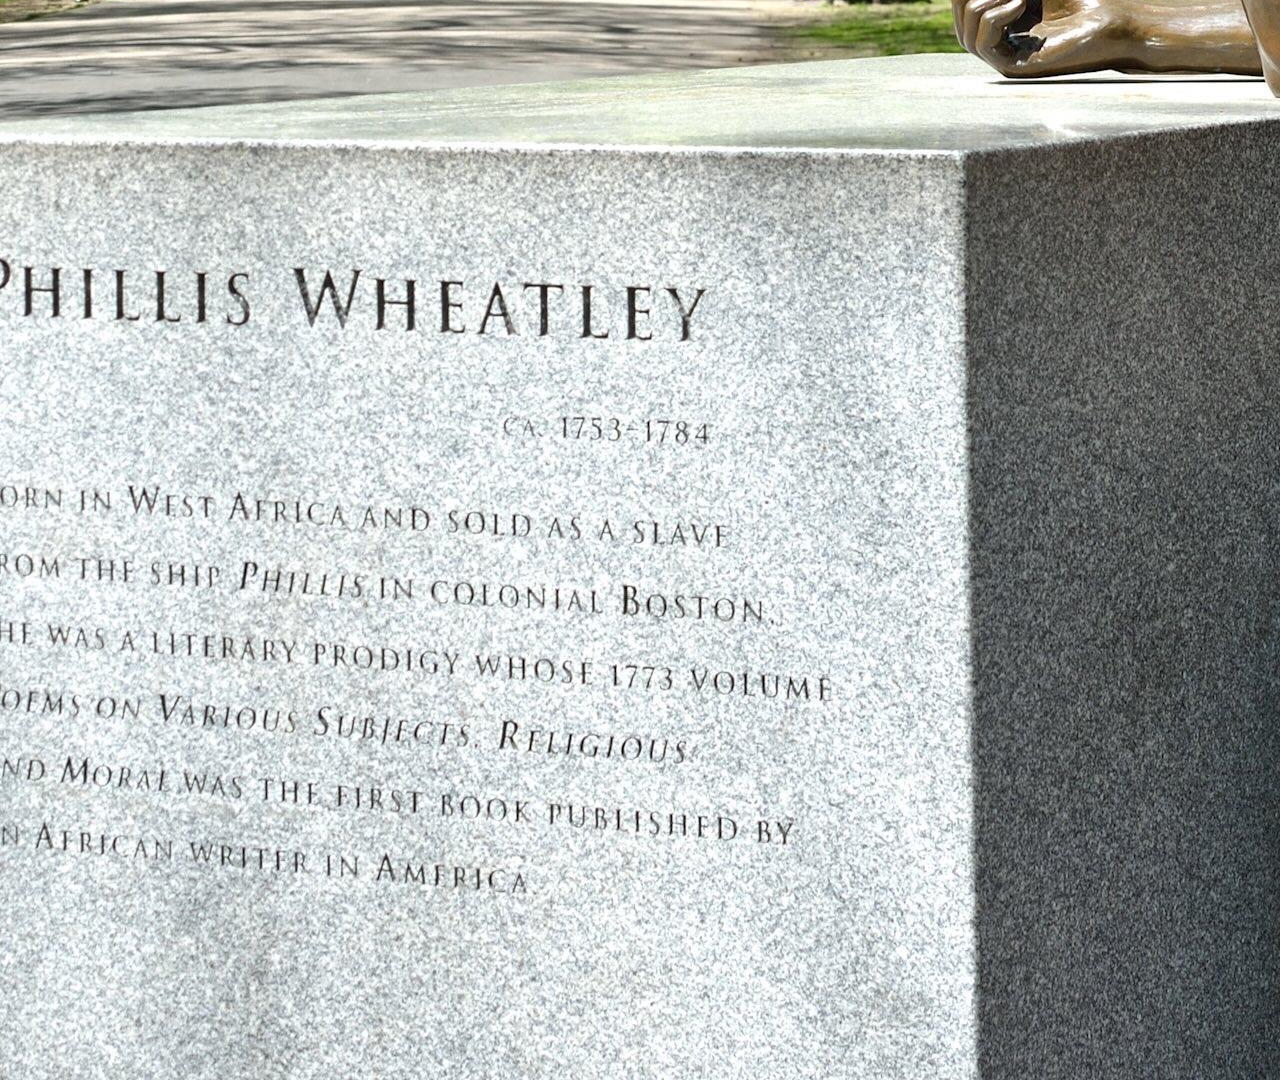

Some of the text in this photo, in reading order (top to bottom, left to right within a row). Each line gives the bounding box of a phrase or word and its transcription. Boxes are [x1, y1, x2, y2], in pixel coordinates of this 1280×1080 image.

[292, 267, 708, 342] WHEATLEY
[561, 416, 709, 445] 1753-1784
[80, 489, 112, 512] IN
[127, 485, 215, 519] WEST
[228, 492, 349, 528] AFRICA
[363, 505, 430, 532] AND
[447, 510, 532, 537] SOLD
[547, 517, 582, 540] AS
[598, 519, 615, 541] A
[633, 520, 728, 547] SLAVE
[76, 557, 135, 583] THE
[150, 562, 220, 588] SHIP
[239, 561, 363, 598] PHILLIS
[380, 577, 413, 600] IN
[430, 580, 603, 614] COLONIAL
[46, 624, 105, 650] WAS
[120, 630, 136, 652] A
[153, 631, 298, 664] LITERARY
[314, 643, 459, 675] PRODIGY
[475, 654, 593, 685] WHOSE
[611, 664, 673, 691] 1773
[690, 668, 832, 701] VOLUME
[96, 696, 142, 720] ON
[159, 694, 298, 734] VARIOUS
[499, 720, 687, 764] RELIGIOUS
[61, 756, 168, 792] MORAL
[183, 772, 243, 799] WAS
[260, 778, 319, 805] THE
[337, 785, 424, 813] FIRST
[441, 794, 529, 822] BOOK
[549, 803, 738, 841] PUBLISHED
[757, 821, 794, 845] BY
[35, 822, 173, 861] AFRICAN
[190, 841, 309, 873] WRITER
[326, 856, 359, 877] IN
